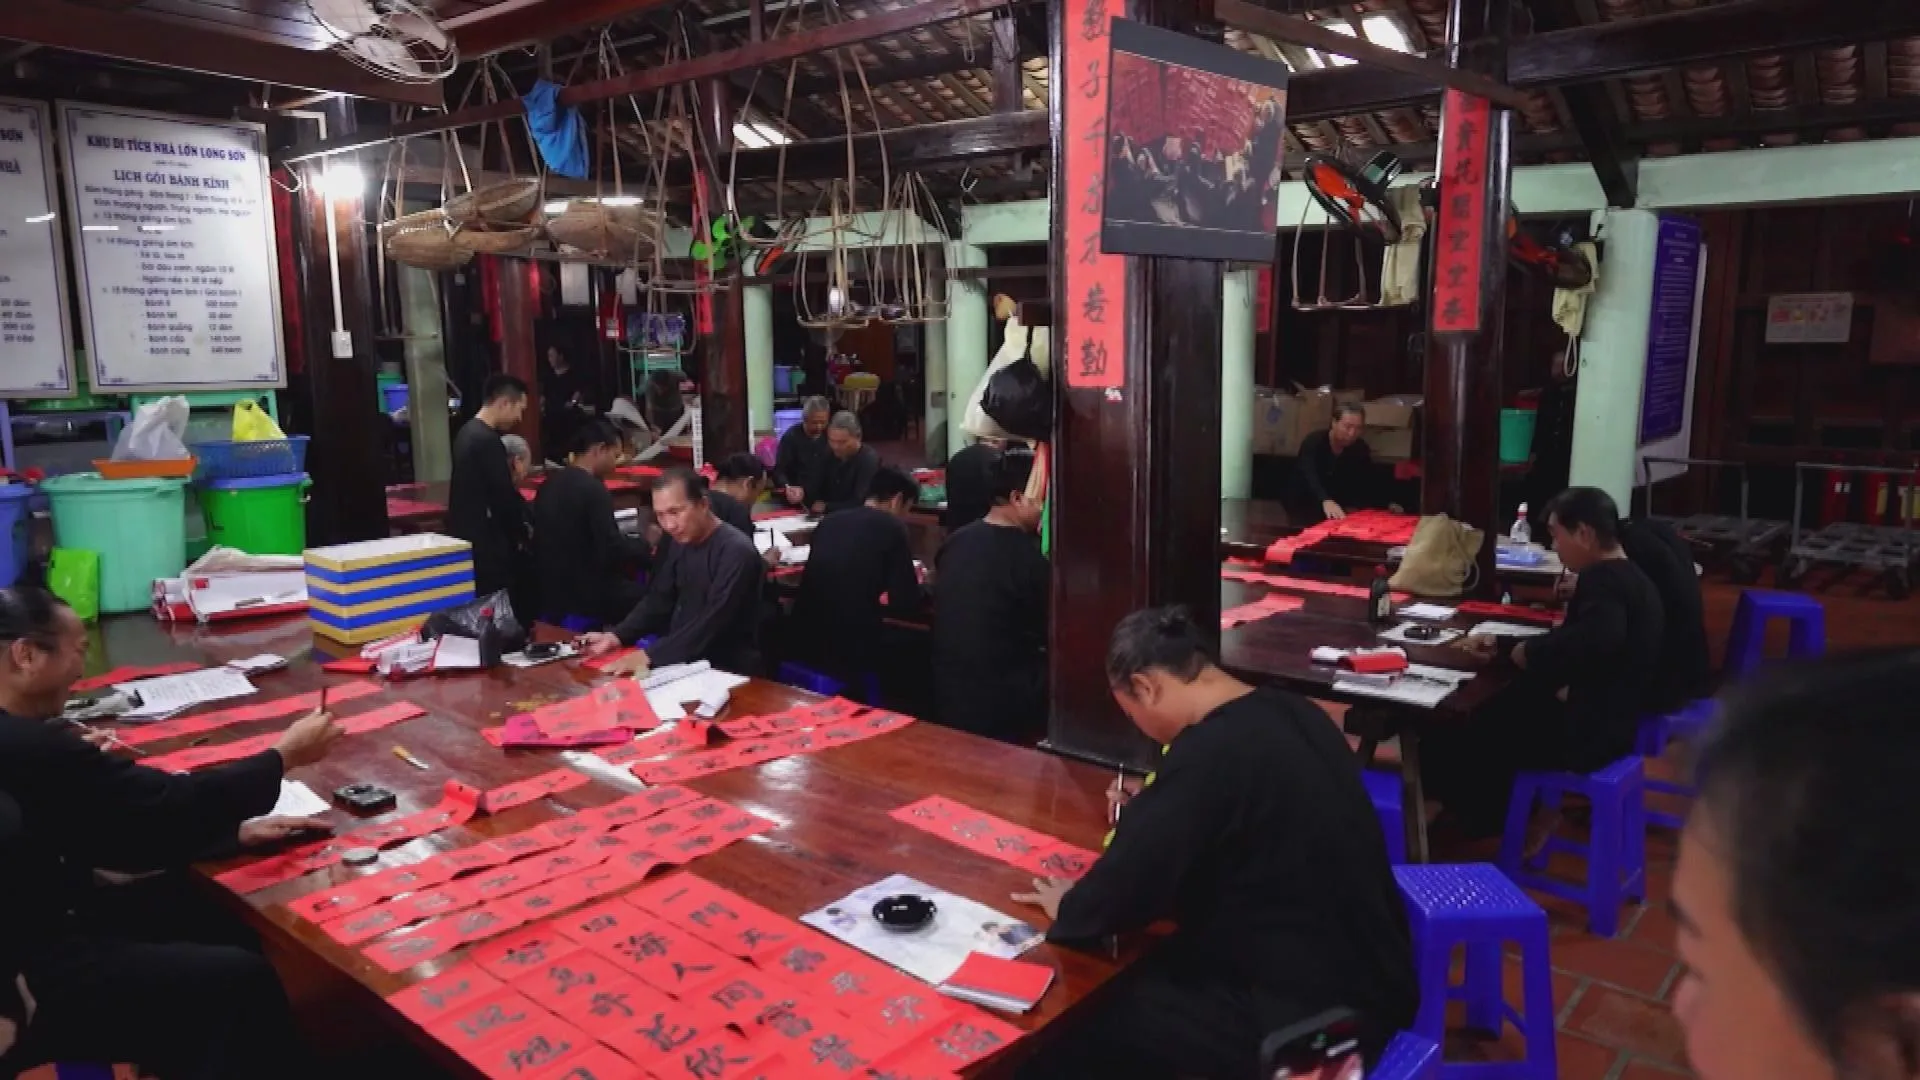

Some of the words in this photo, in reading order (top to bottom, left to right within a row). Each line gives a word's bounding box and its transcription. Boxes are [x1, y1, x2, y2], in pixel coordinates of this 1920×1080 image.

[87, 135, 111, 148] KHU
[127, 137, 151, 152] TÍCH
[201, 148, 226, 160] LONG
